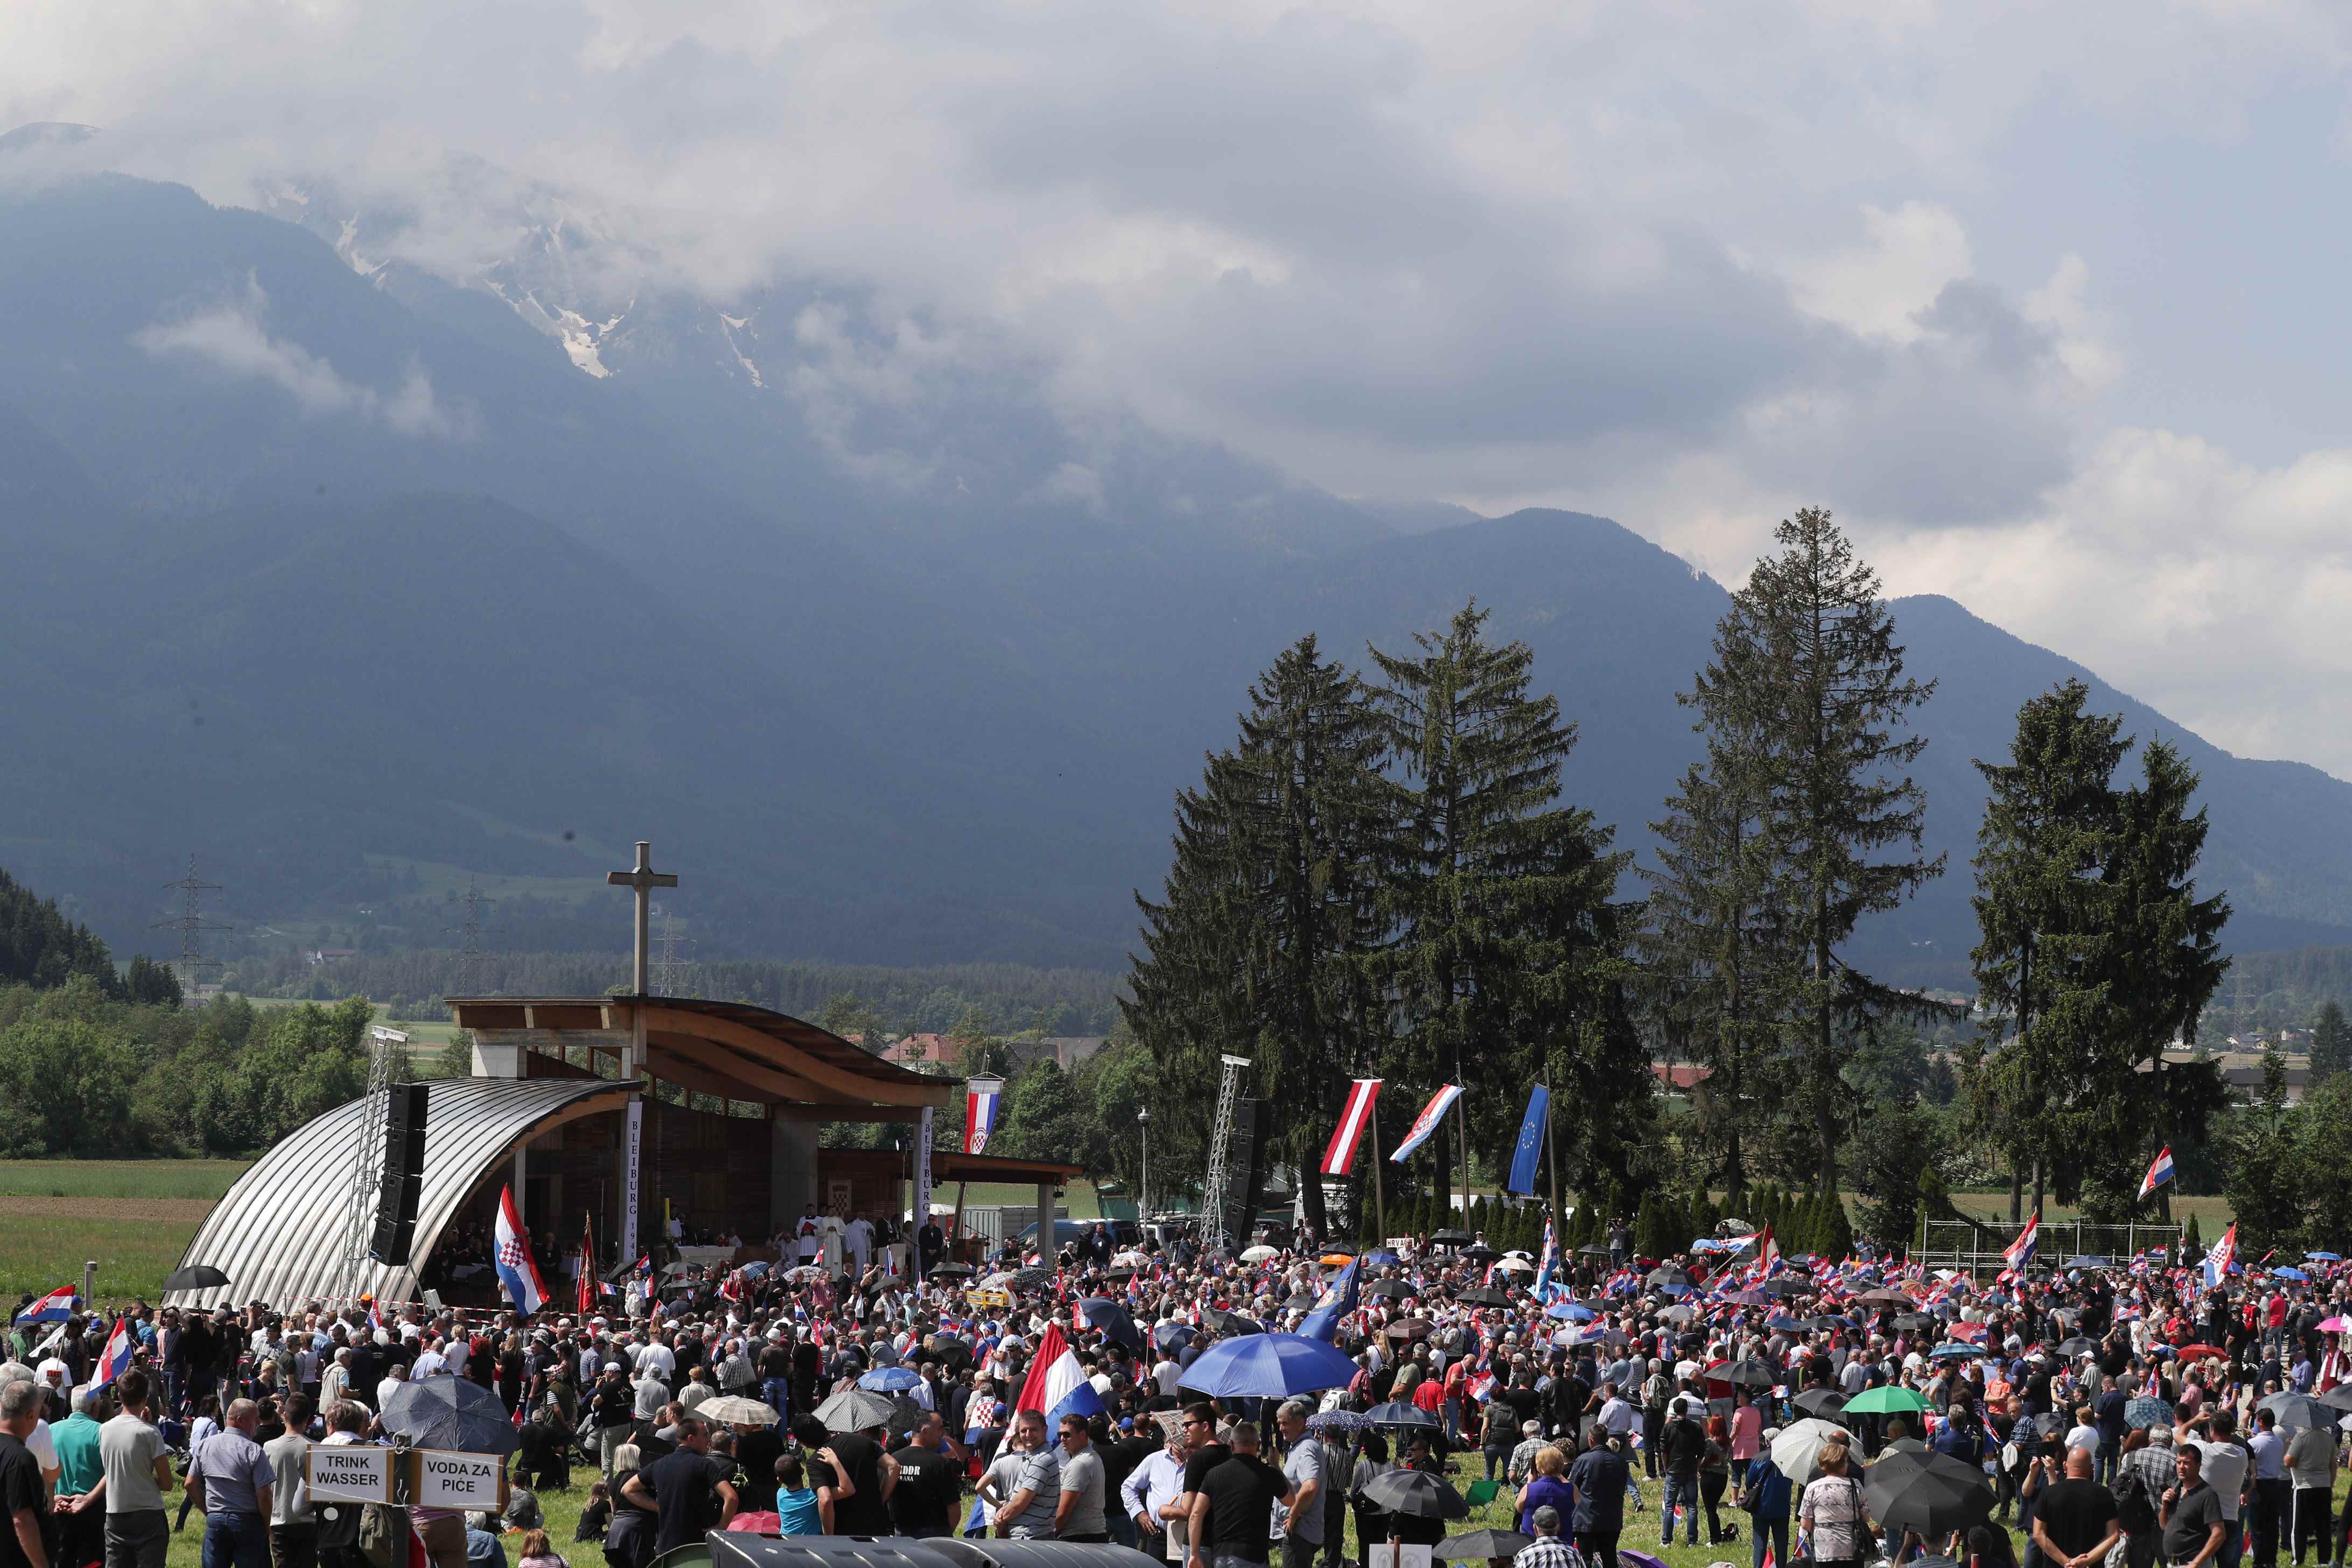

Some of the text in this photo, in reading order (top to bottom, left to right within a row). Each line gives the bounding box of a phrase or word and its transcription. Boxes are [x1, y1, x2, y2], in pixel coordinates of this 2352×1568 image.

[629, 1121, 638, 1215] BLEIBURG
[923, 1124, 931, 1212] BLEIBURG
[326, 1456, 369, 1469] TRINK
[428, 1461, 491, 1476] VODA ZA
[317, 1472, 379, 1486] WASSER
[442, 1478, 475, 1493] PIĆE
